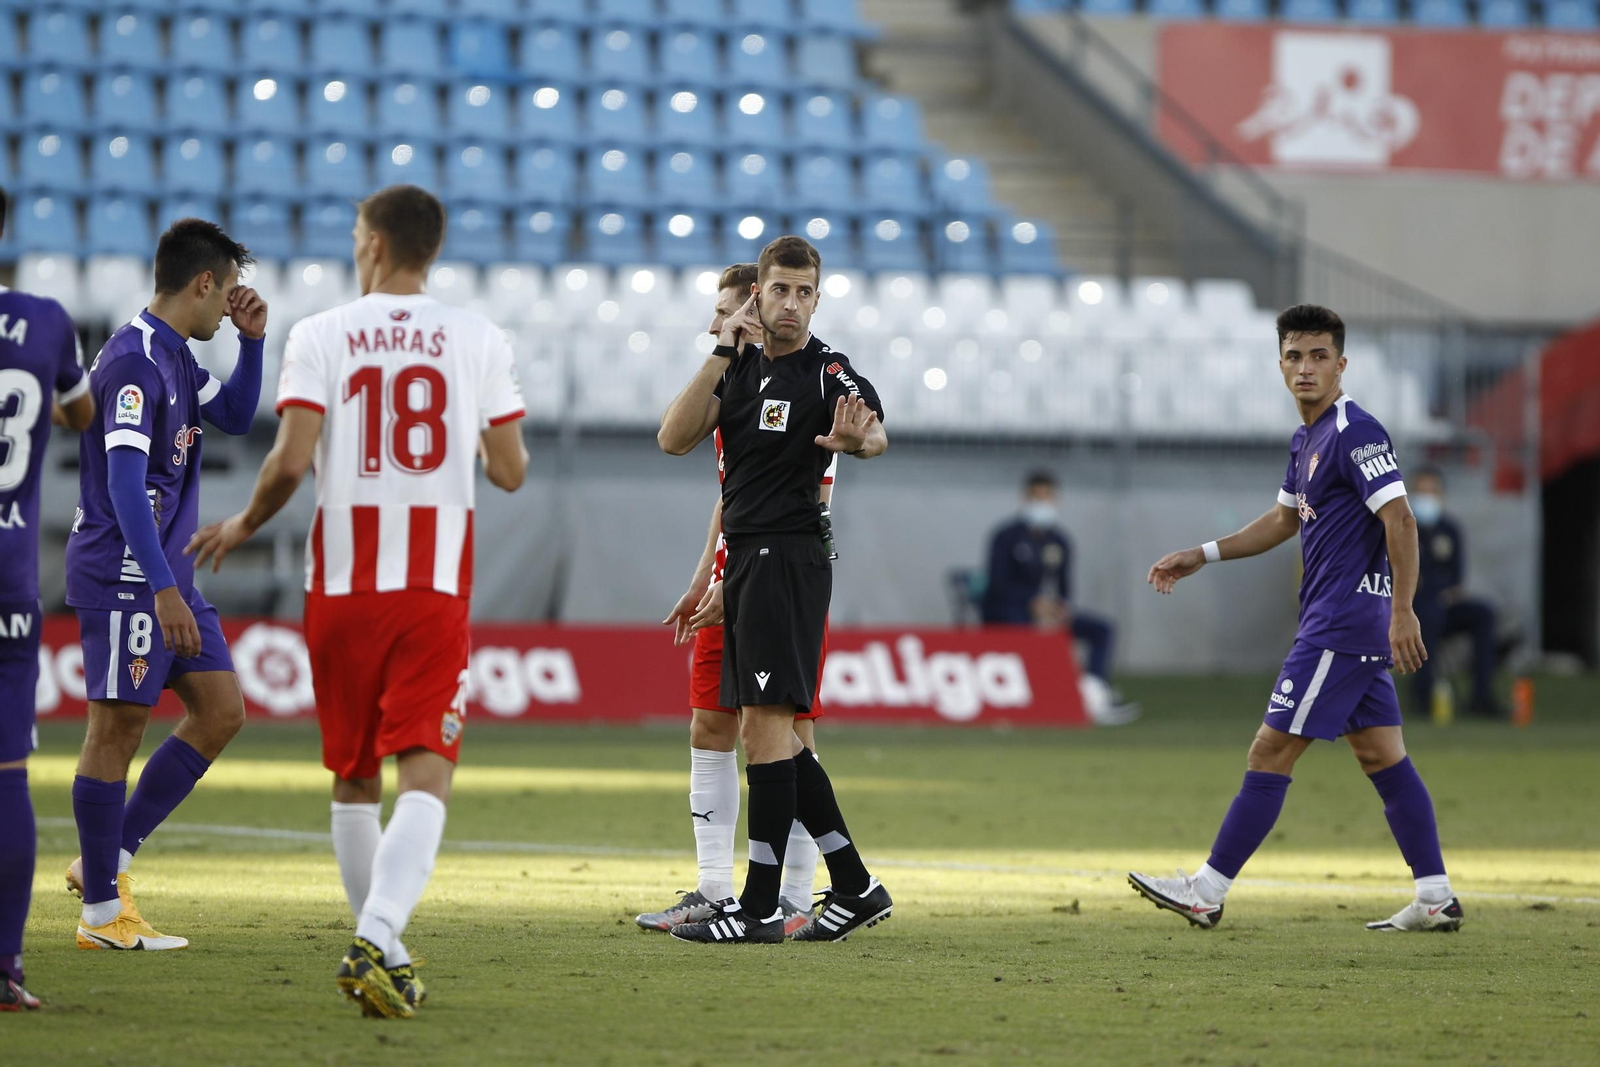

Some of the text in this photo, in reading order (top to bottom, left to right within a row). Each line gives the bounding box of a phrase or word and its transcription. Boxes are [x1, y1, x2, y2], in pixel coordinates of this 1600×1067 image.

[118, 411, 139, 420] LaLiga
[342, 364, 448, 477] 18
[128, 612, 153, 656] 8
[821, 635, 1031, 721] aLiga
